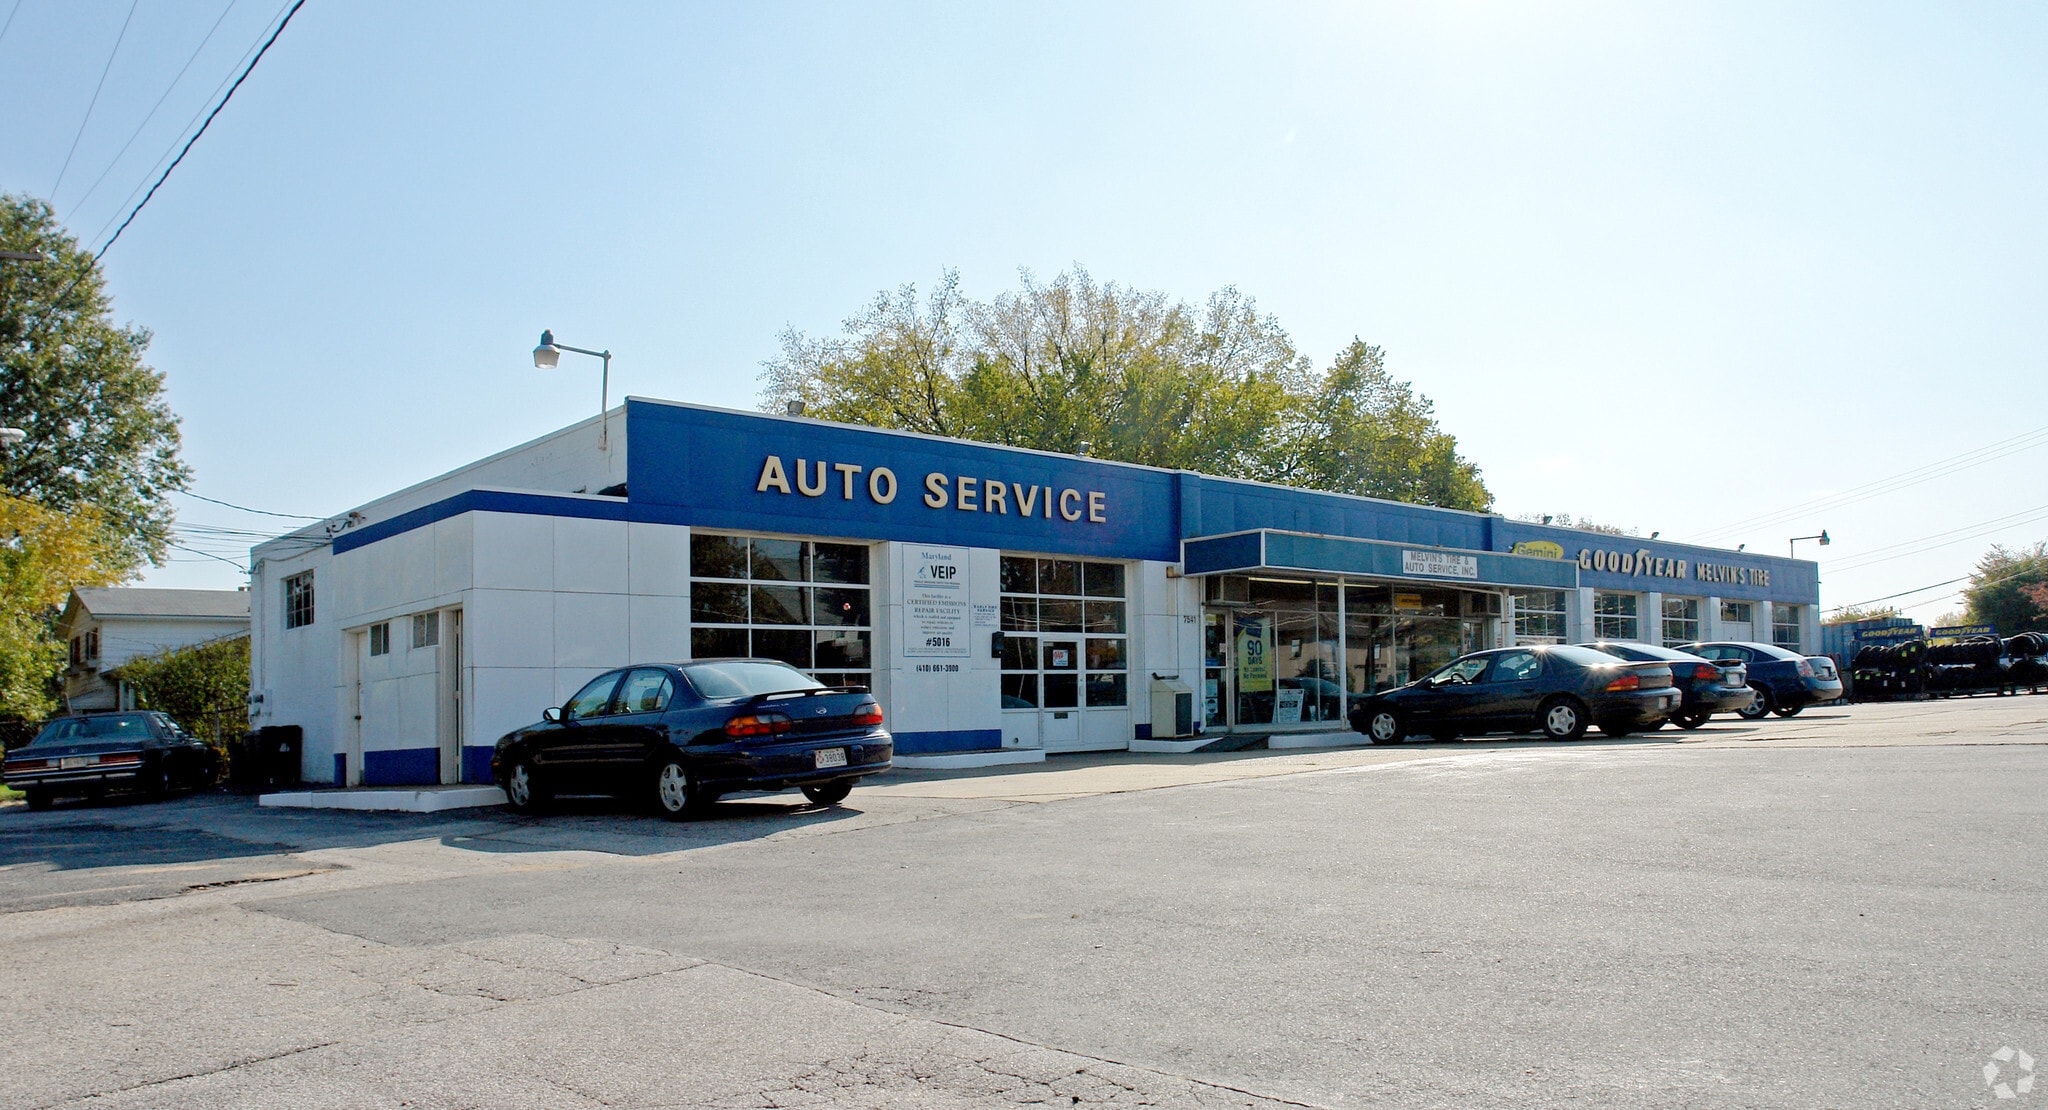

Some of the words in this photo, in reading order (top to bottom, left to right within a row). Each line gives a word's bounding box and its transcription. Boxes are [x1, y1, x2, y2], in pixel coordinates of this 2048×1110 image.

[757, 455, 898, 504] AUTO
[924, 472, 1107, 523] SERVICE
[921, 552, 952, 561] Maryland
[1410, 551, 1442, 563] MELVIN'S
[1446, 554, 1461, 564] TIRE
[1517, 542, 1559, 560] Gemini
[1404, 562, 1424, 572] AUTO
[1461, 567, 1475, 576] INC.
[1579, 548, 1687, 579] GOODYEAR
[930, 565, 957, 579] VEIP
[1696, 562, 1745, 584] MELVIN'S
[1748, 568, 1770, 586] TIRE
[1183, 615, 1197, 624] 7541
[1862, 627, 1917, 637] GOODYEAR
[1935, 626, 1991, 636] GOODYEAR
[926, 637, 951, 647] #5016
[1247, 640, 1263, 656] 90
[1248, 656, 1263, 665] DAYS
